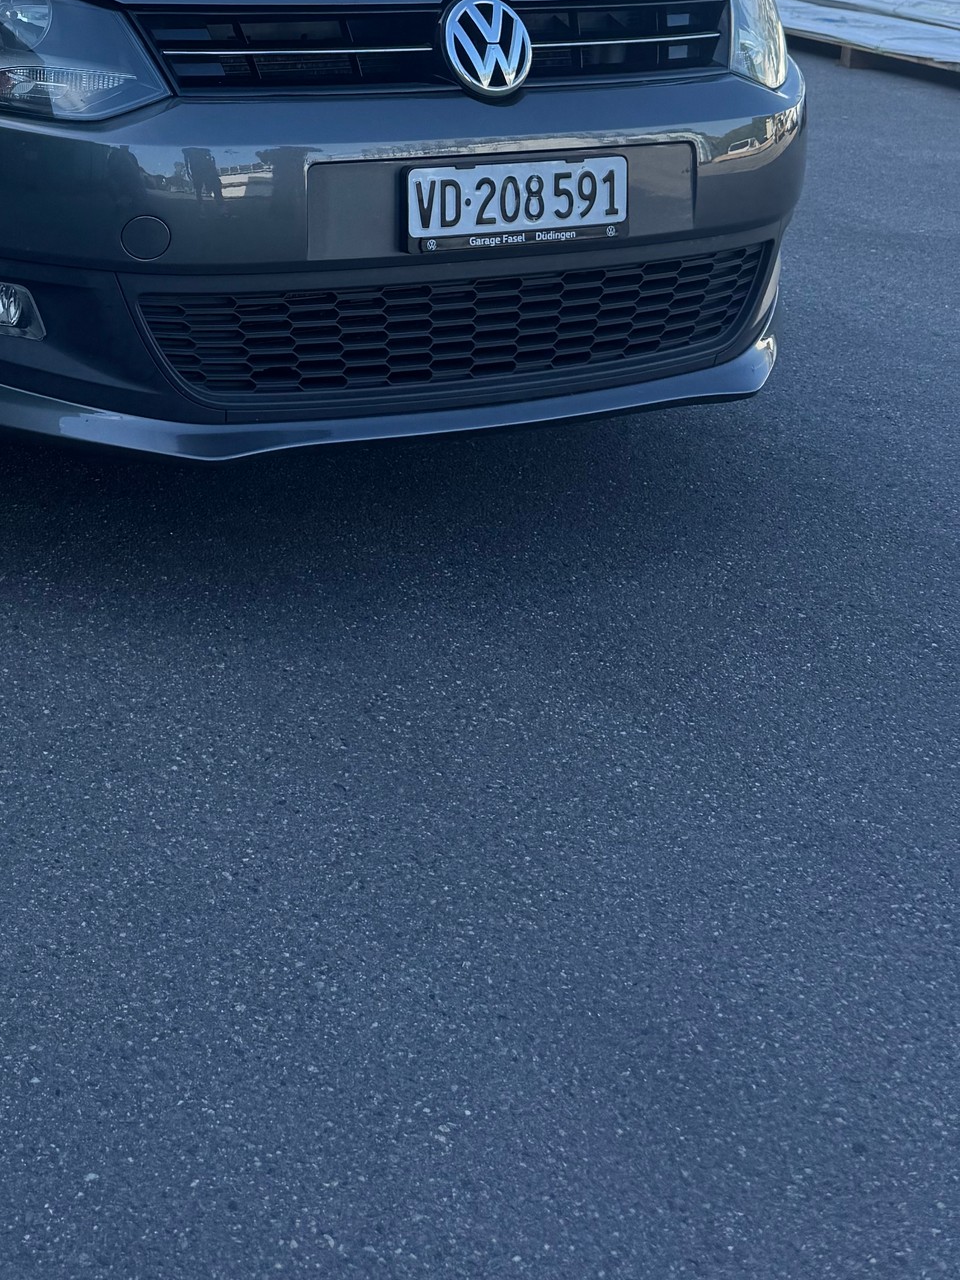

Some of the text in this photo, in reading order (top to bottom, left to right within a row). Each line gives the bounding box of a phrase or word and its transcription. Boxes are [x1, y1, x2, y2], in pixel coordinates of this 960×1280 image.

[469, 230, 576, 246] Garage Fasel Düdingen
